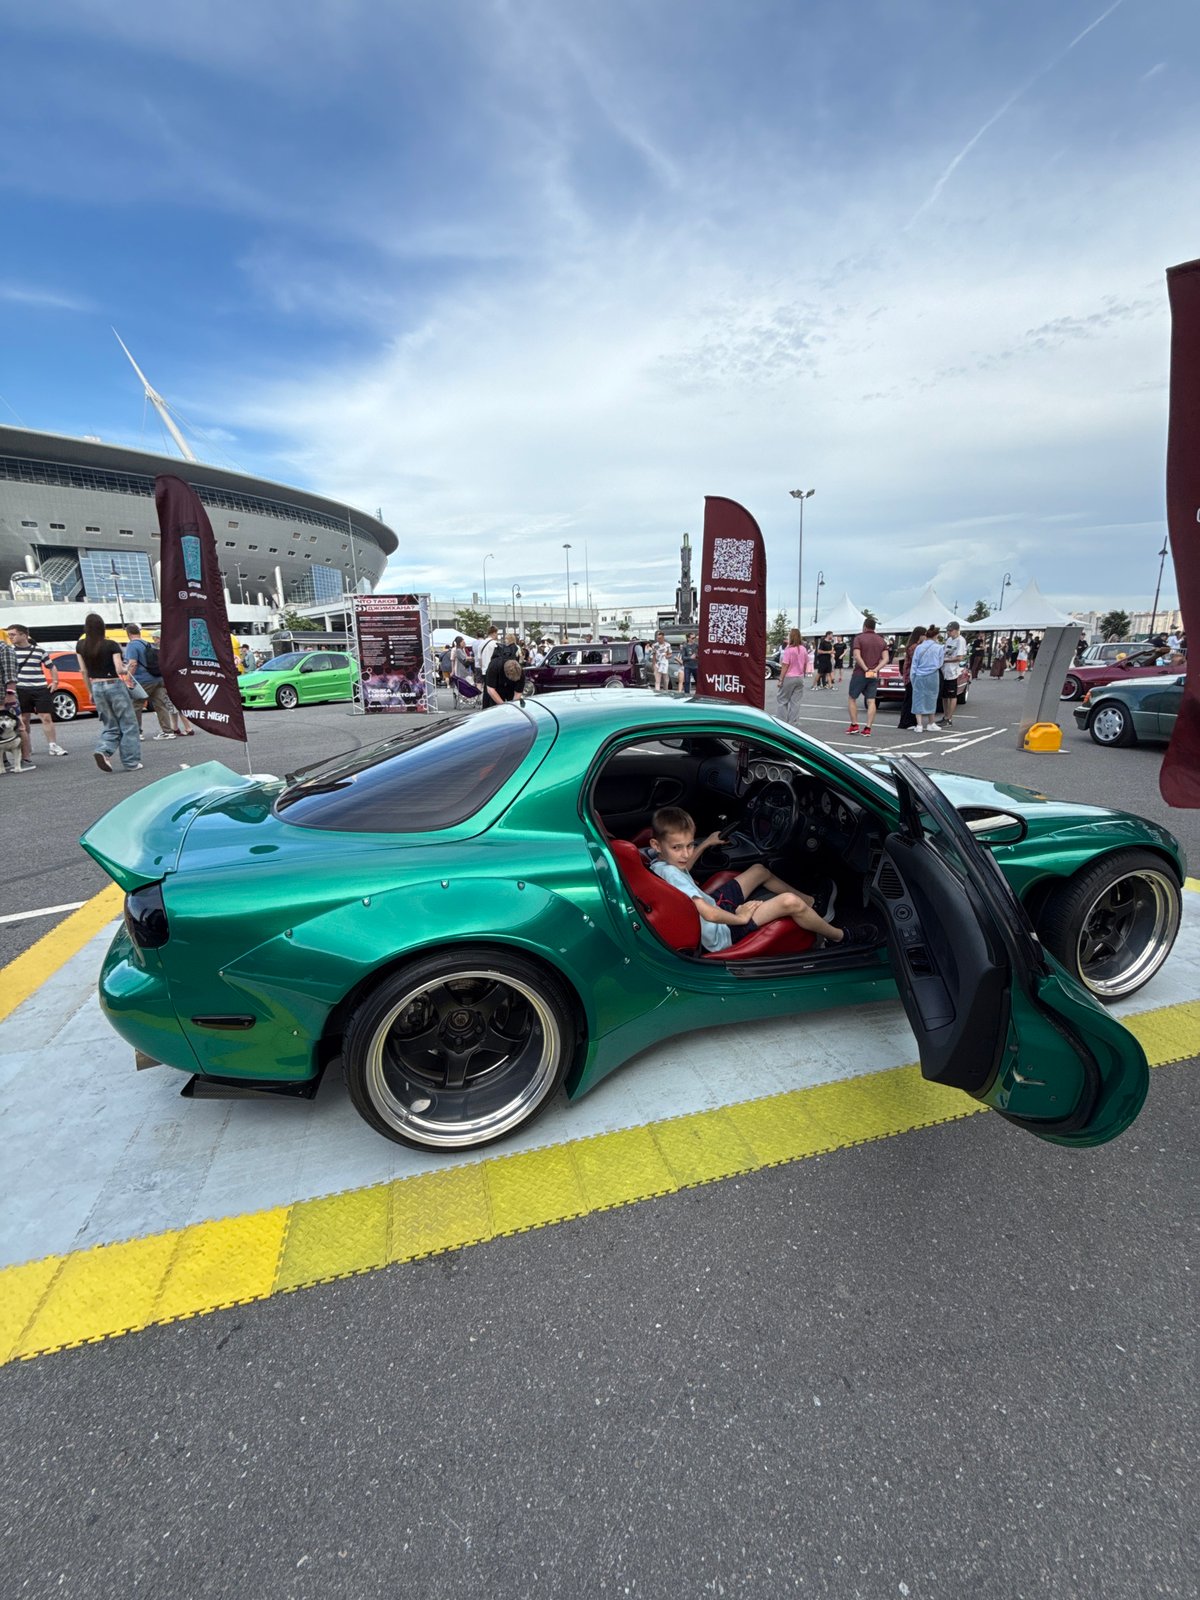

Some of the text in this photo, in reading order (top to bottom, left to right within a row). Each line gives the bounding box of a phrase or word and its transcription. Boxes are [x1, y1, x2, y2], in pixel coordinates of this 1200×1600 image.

[705, 673, 740, 685] WHITE
[714, 683, 746, 693] NIGHT
[181, 709, 230, 723] WHITE NIGHT
